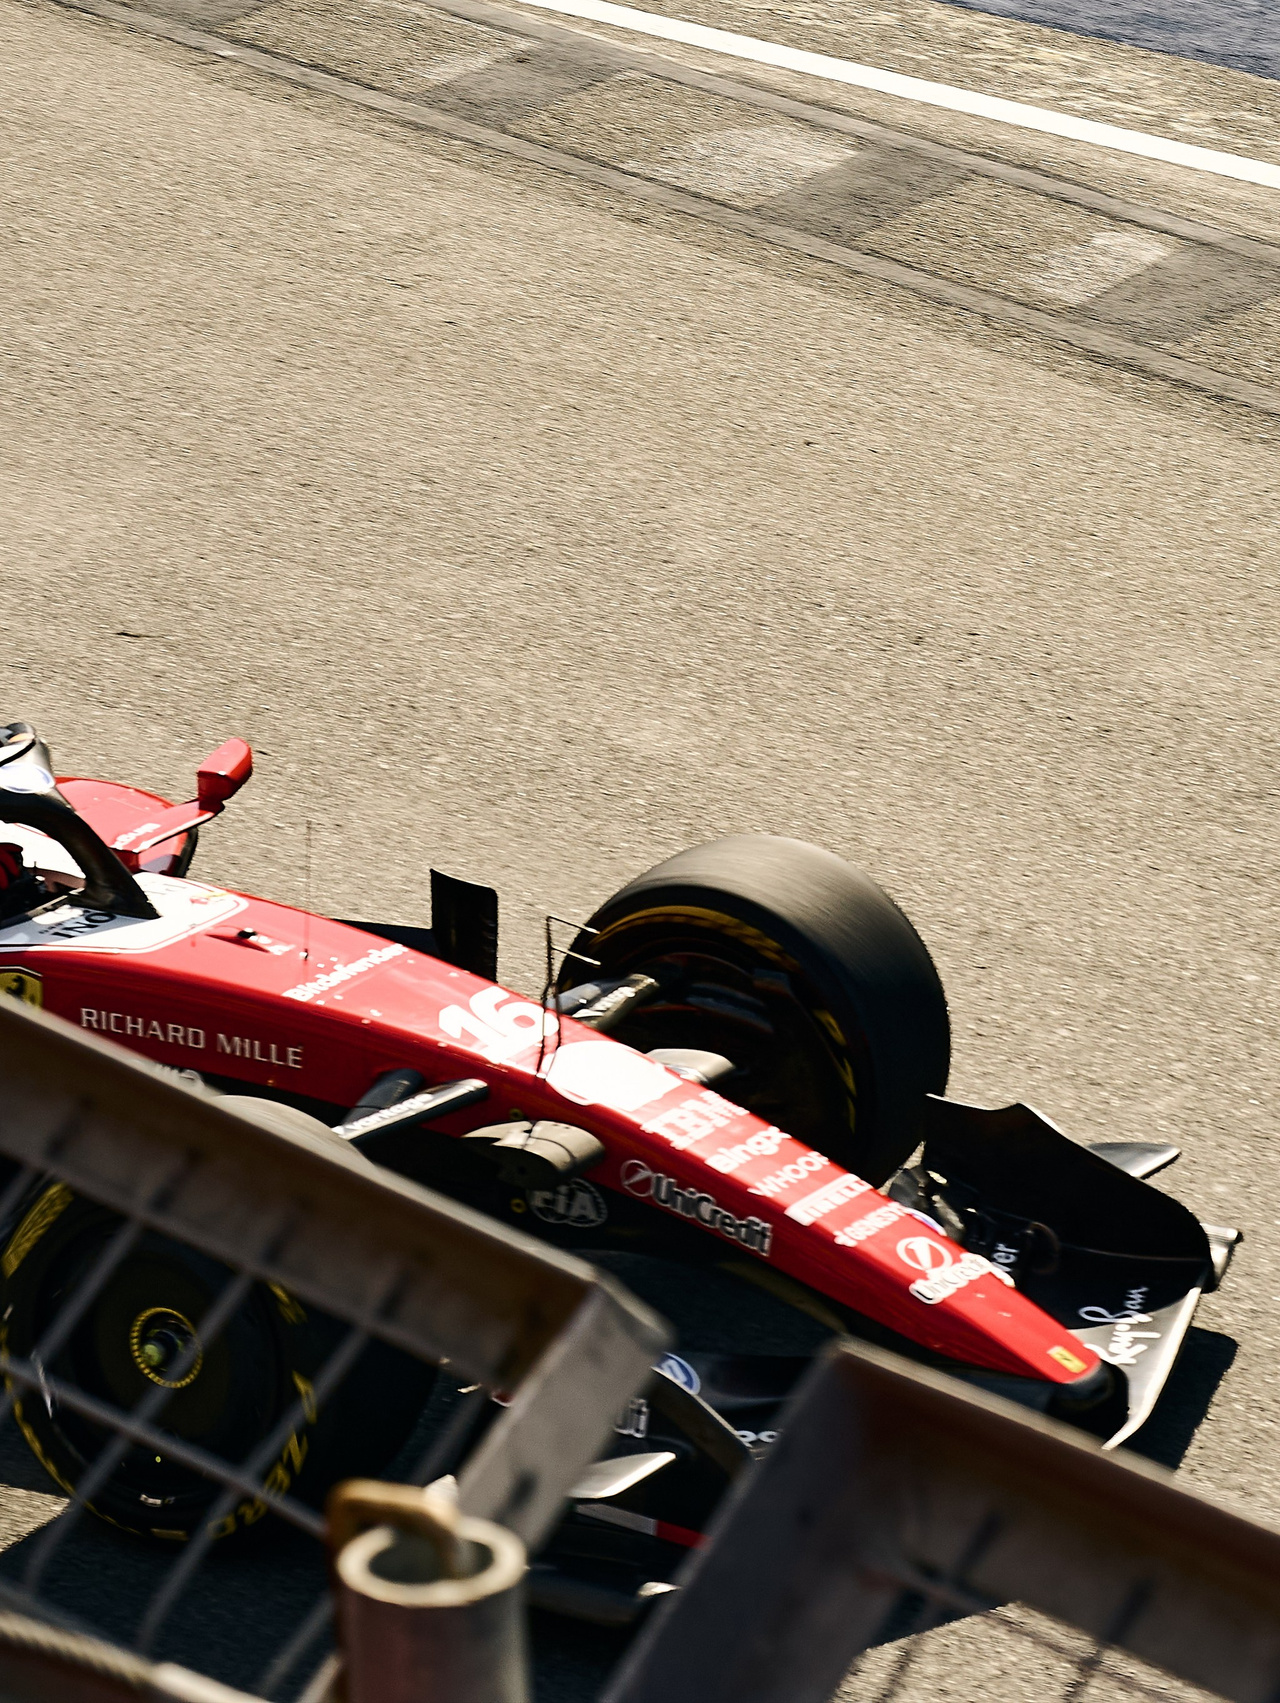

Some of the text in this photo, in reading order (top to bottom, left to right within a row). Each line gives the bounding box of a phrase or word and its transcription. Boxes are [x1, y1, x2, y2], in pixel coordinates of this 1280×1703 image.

[281, 943, 409, 1002] Bitdefender
[80, 1007, 304, 1069] RICHARD MILLE
[438, 985, 560, 1065] 16
[639, 1089, 751, 1151] IBM
[747, 1151, 831, 1197] WHOOP
[650, 1172, 774, 1258] UniCredit
[842, 1201, 908, 1241] GENESY
[1078, 1285, 1162, 1365] Ray-Ban
